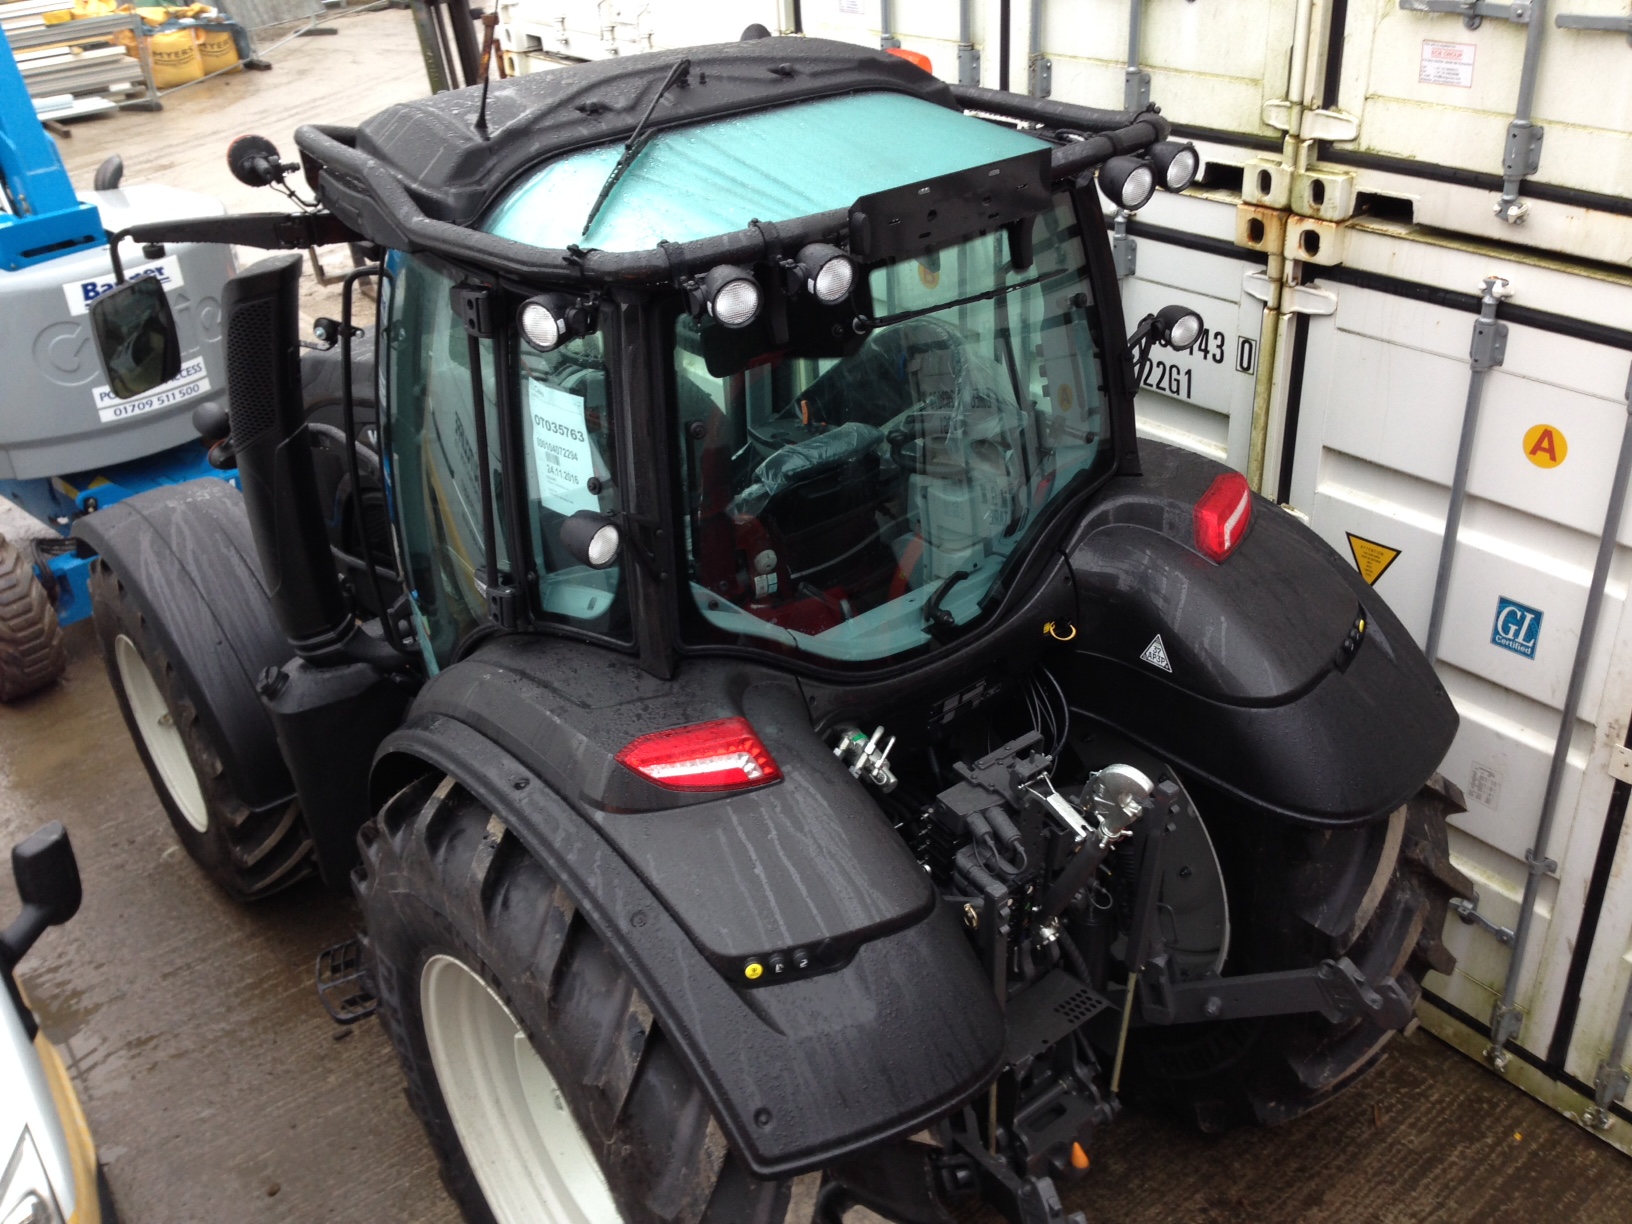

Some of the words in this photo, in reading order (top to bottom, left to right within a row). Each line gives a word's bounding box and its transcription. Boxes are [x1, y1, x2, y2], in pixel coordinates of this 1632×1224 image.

[152, 45, 193, 59] MYERS
[81, 266, 166, 302] Baer
[1239, 339, 1253, 372] 0
[1143, 357, 1192, 400] 22G1
[114, 399, 154, 417] 01709
[157, 391, 176, 406] 511
[178, 384, 200, 399] 500
[1528, 428, 1558, 463] A
[546, 464, 580, 485] 24.11.2016
[1496, 604, 1536, 649] GL
[1495, 633, 1532, 656] Certified
